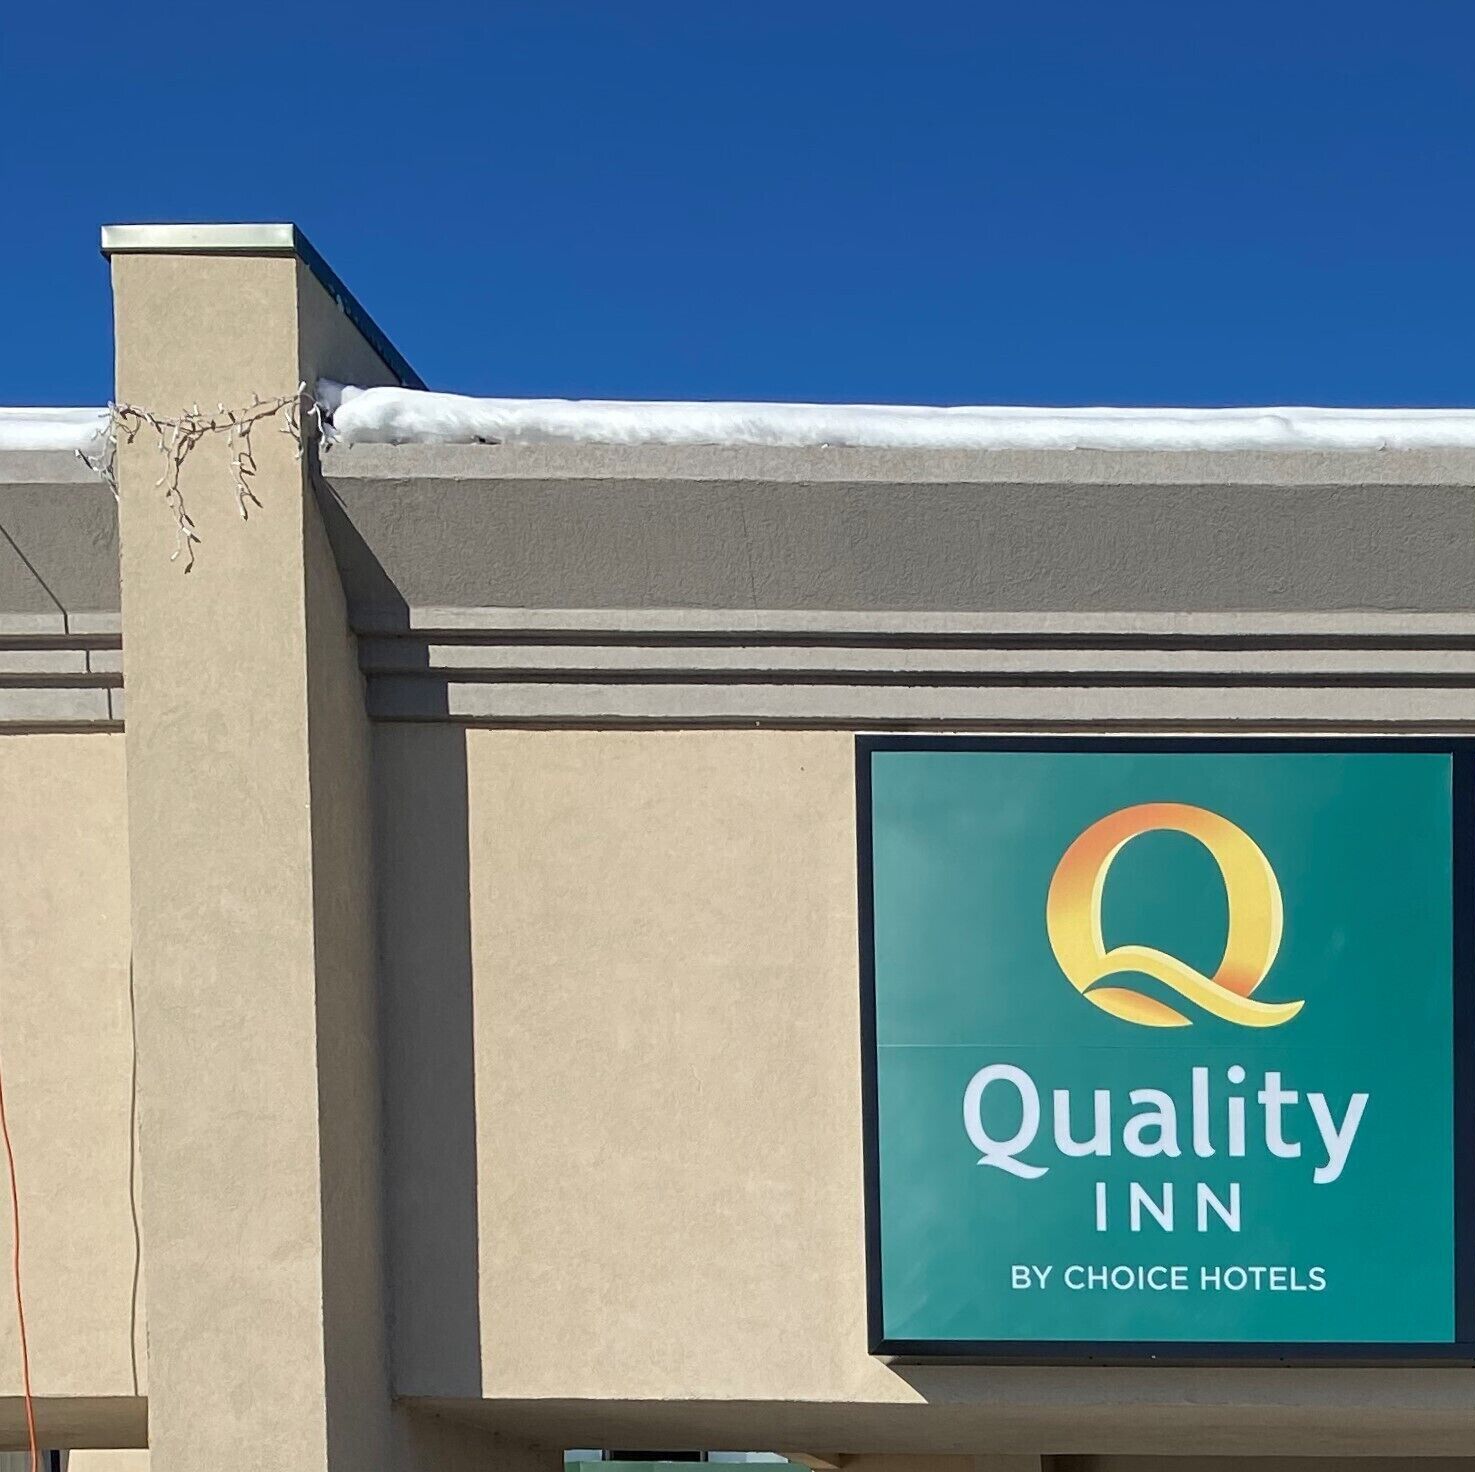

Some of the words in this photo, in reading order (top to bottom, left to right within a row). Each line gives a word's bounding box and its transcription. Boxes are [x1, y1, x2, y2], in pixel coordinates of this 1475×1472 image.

[963, 1063, 1370, 1184] Quality
[1096, 1182, 1241, 1232] INN
[1011, 1265, 1053, 1290] BY
[1064, 1265, 1188, 1291] CHOICE
[1201, 1266, 1327, 1292] HOTELS
